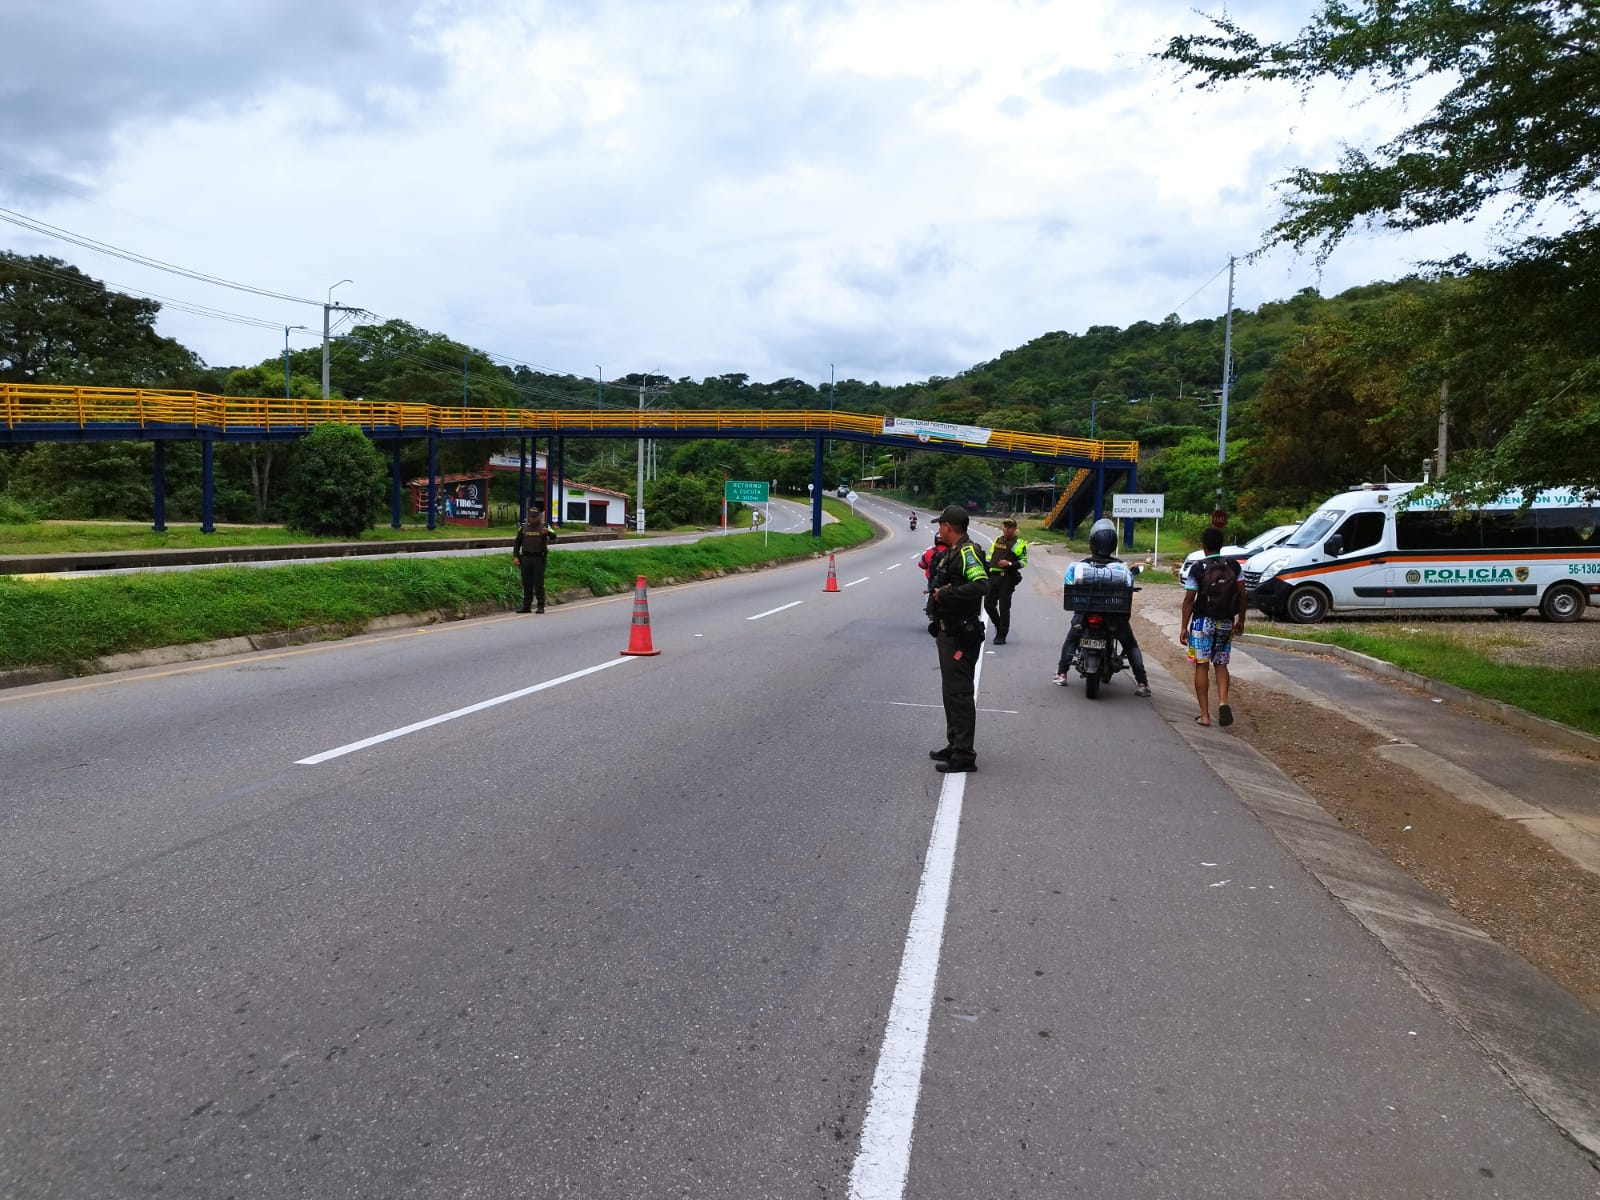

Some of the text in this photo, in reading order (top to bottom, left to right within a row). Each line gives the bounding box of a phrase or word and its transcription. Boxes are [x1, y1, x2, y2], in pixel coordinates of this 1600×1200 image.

[930, 421, 959, 431] nocturno
[455, 498, 472, 508] TIRO
[1424, 566, 1514, 579] POLICÍA
[1568, 563, 1600, 574] 56-1302
